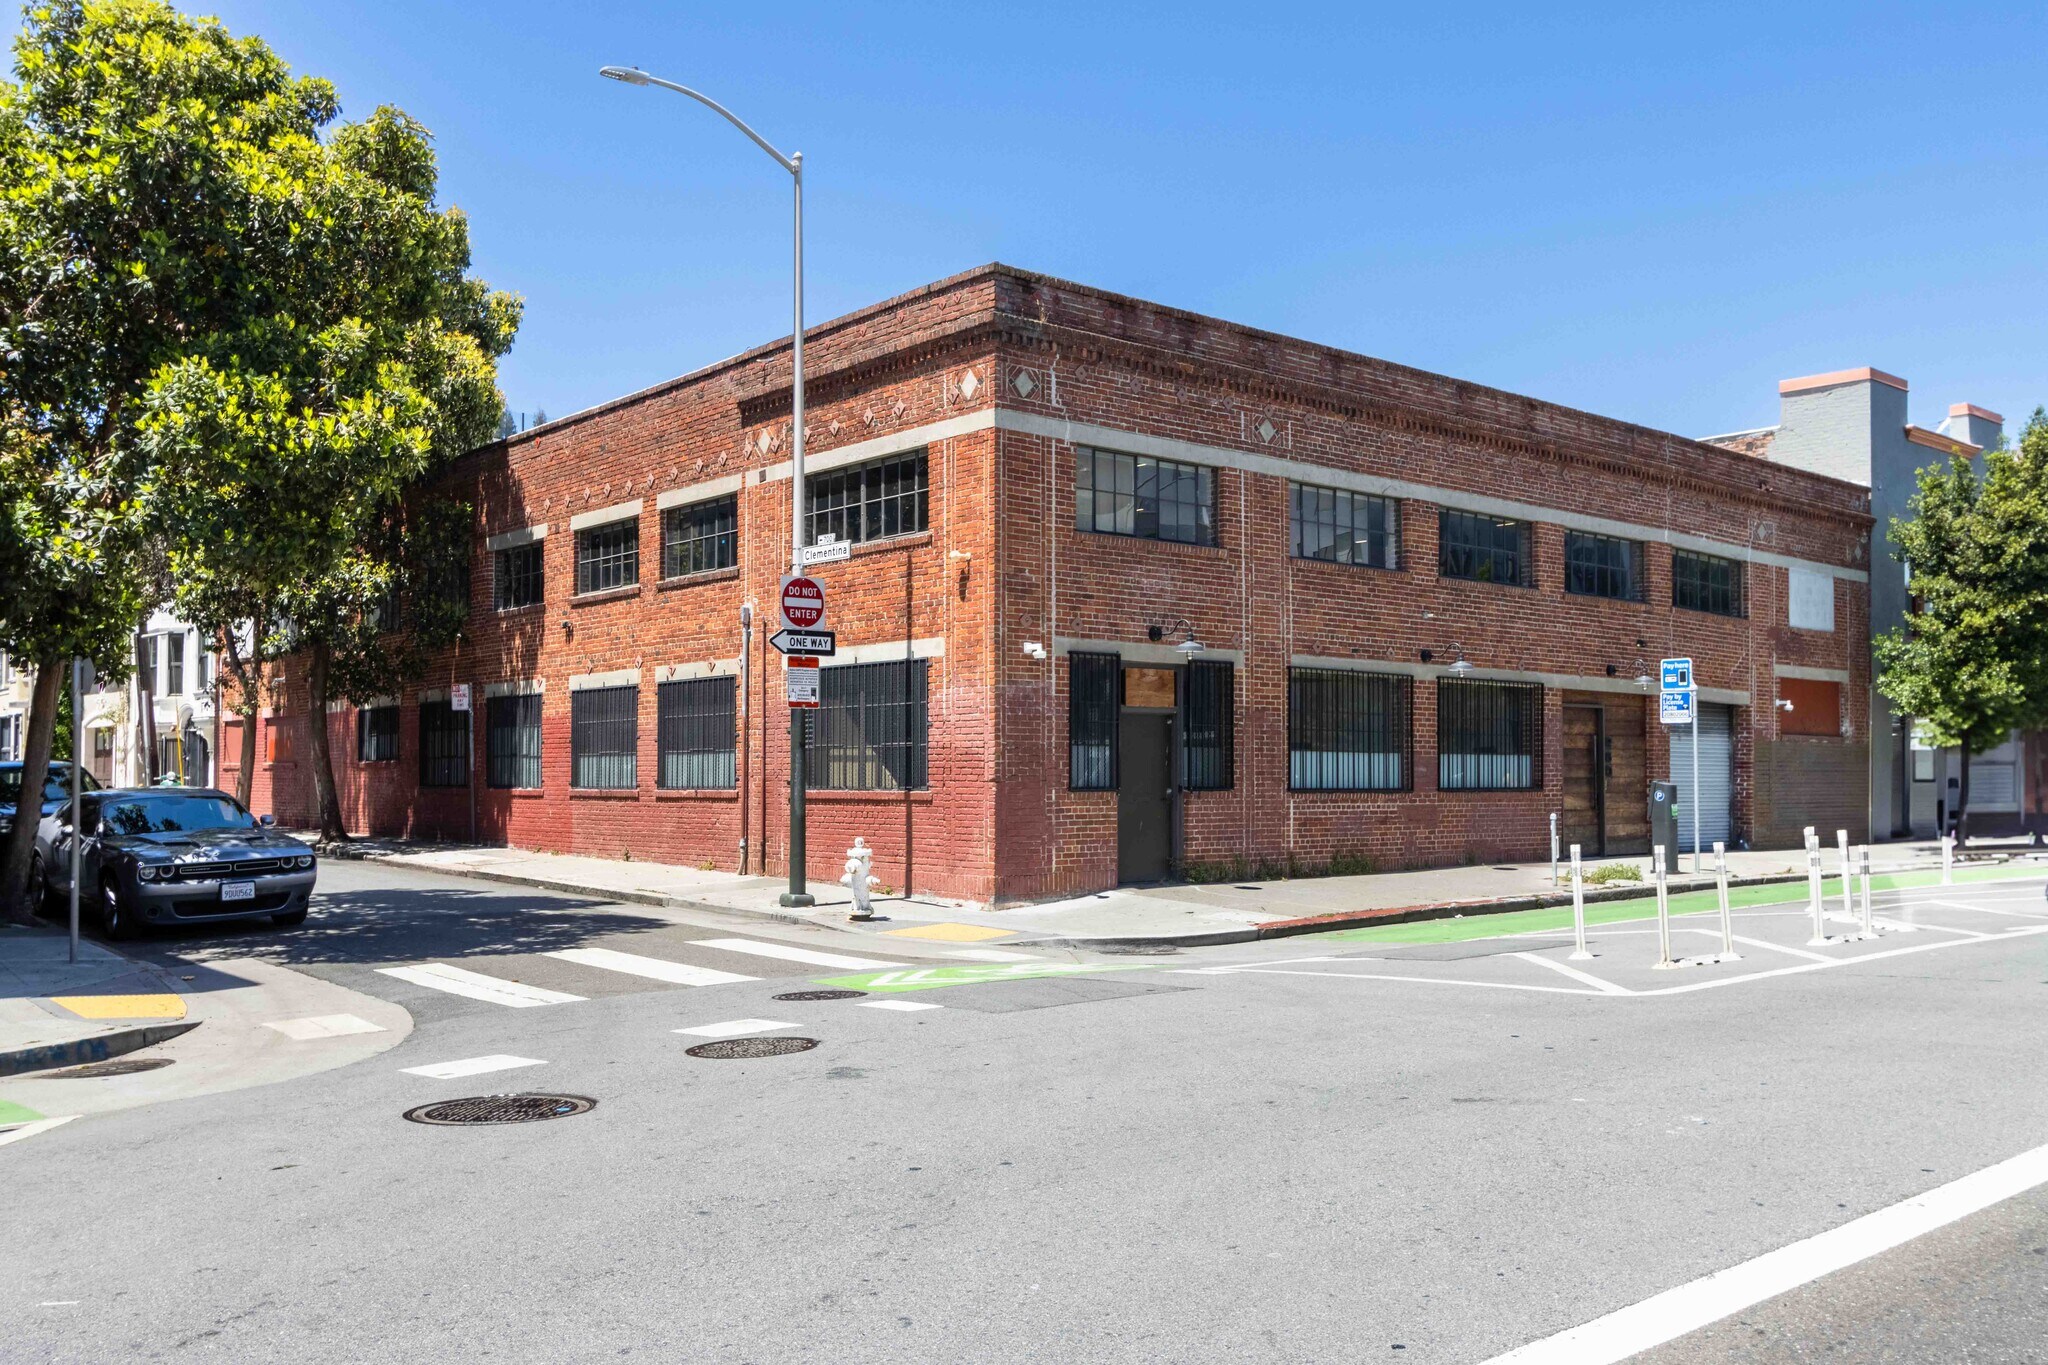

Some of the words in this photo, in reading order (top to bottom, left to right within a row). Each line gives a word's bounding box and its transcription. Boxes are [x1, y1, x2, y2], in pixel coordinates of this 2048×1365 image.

[805, 546, 847, 561] Clementina
[788, 586, 801, 596] DO
[802, 587, 818, 597] NOT
[789, 608, 817, 619] ENTER
[789, 637, 808, 647] ONE
[810, 638, 829, 648] WAY
[1663, 662, 1675, 670] Pay
